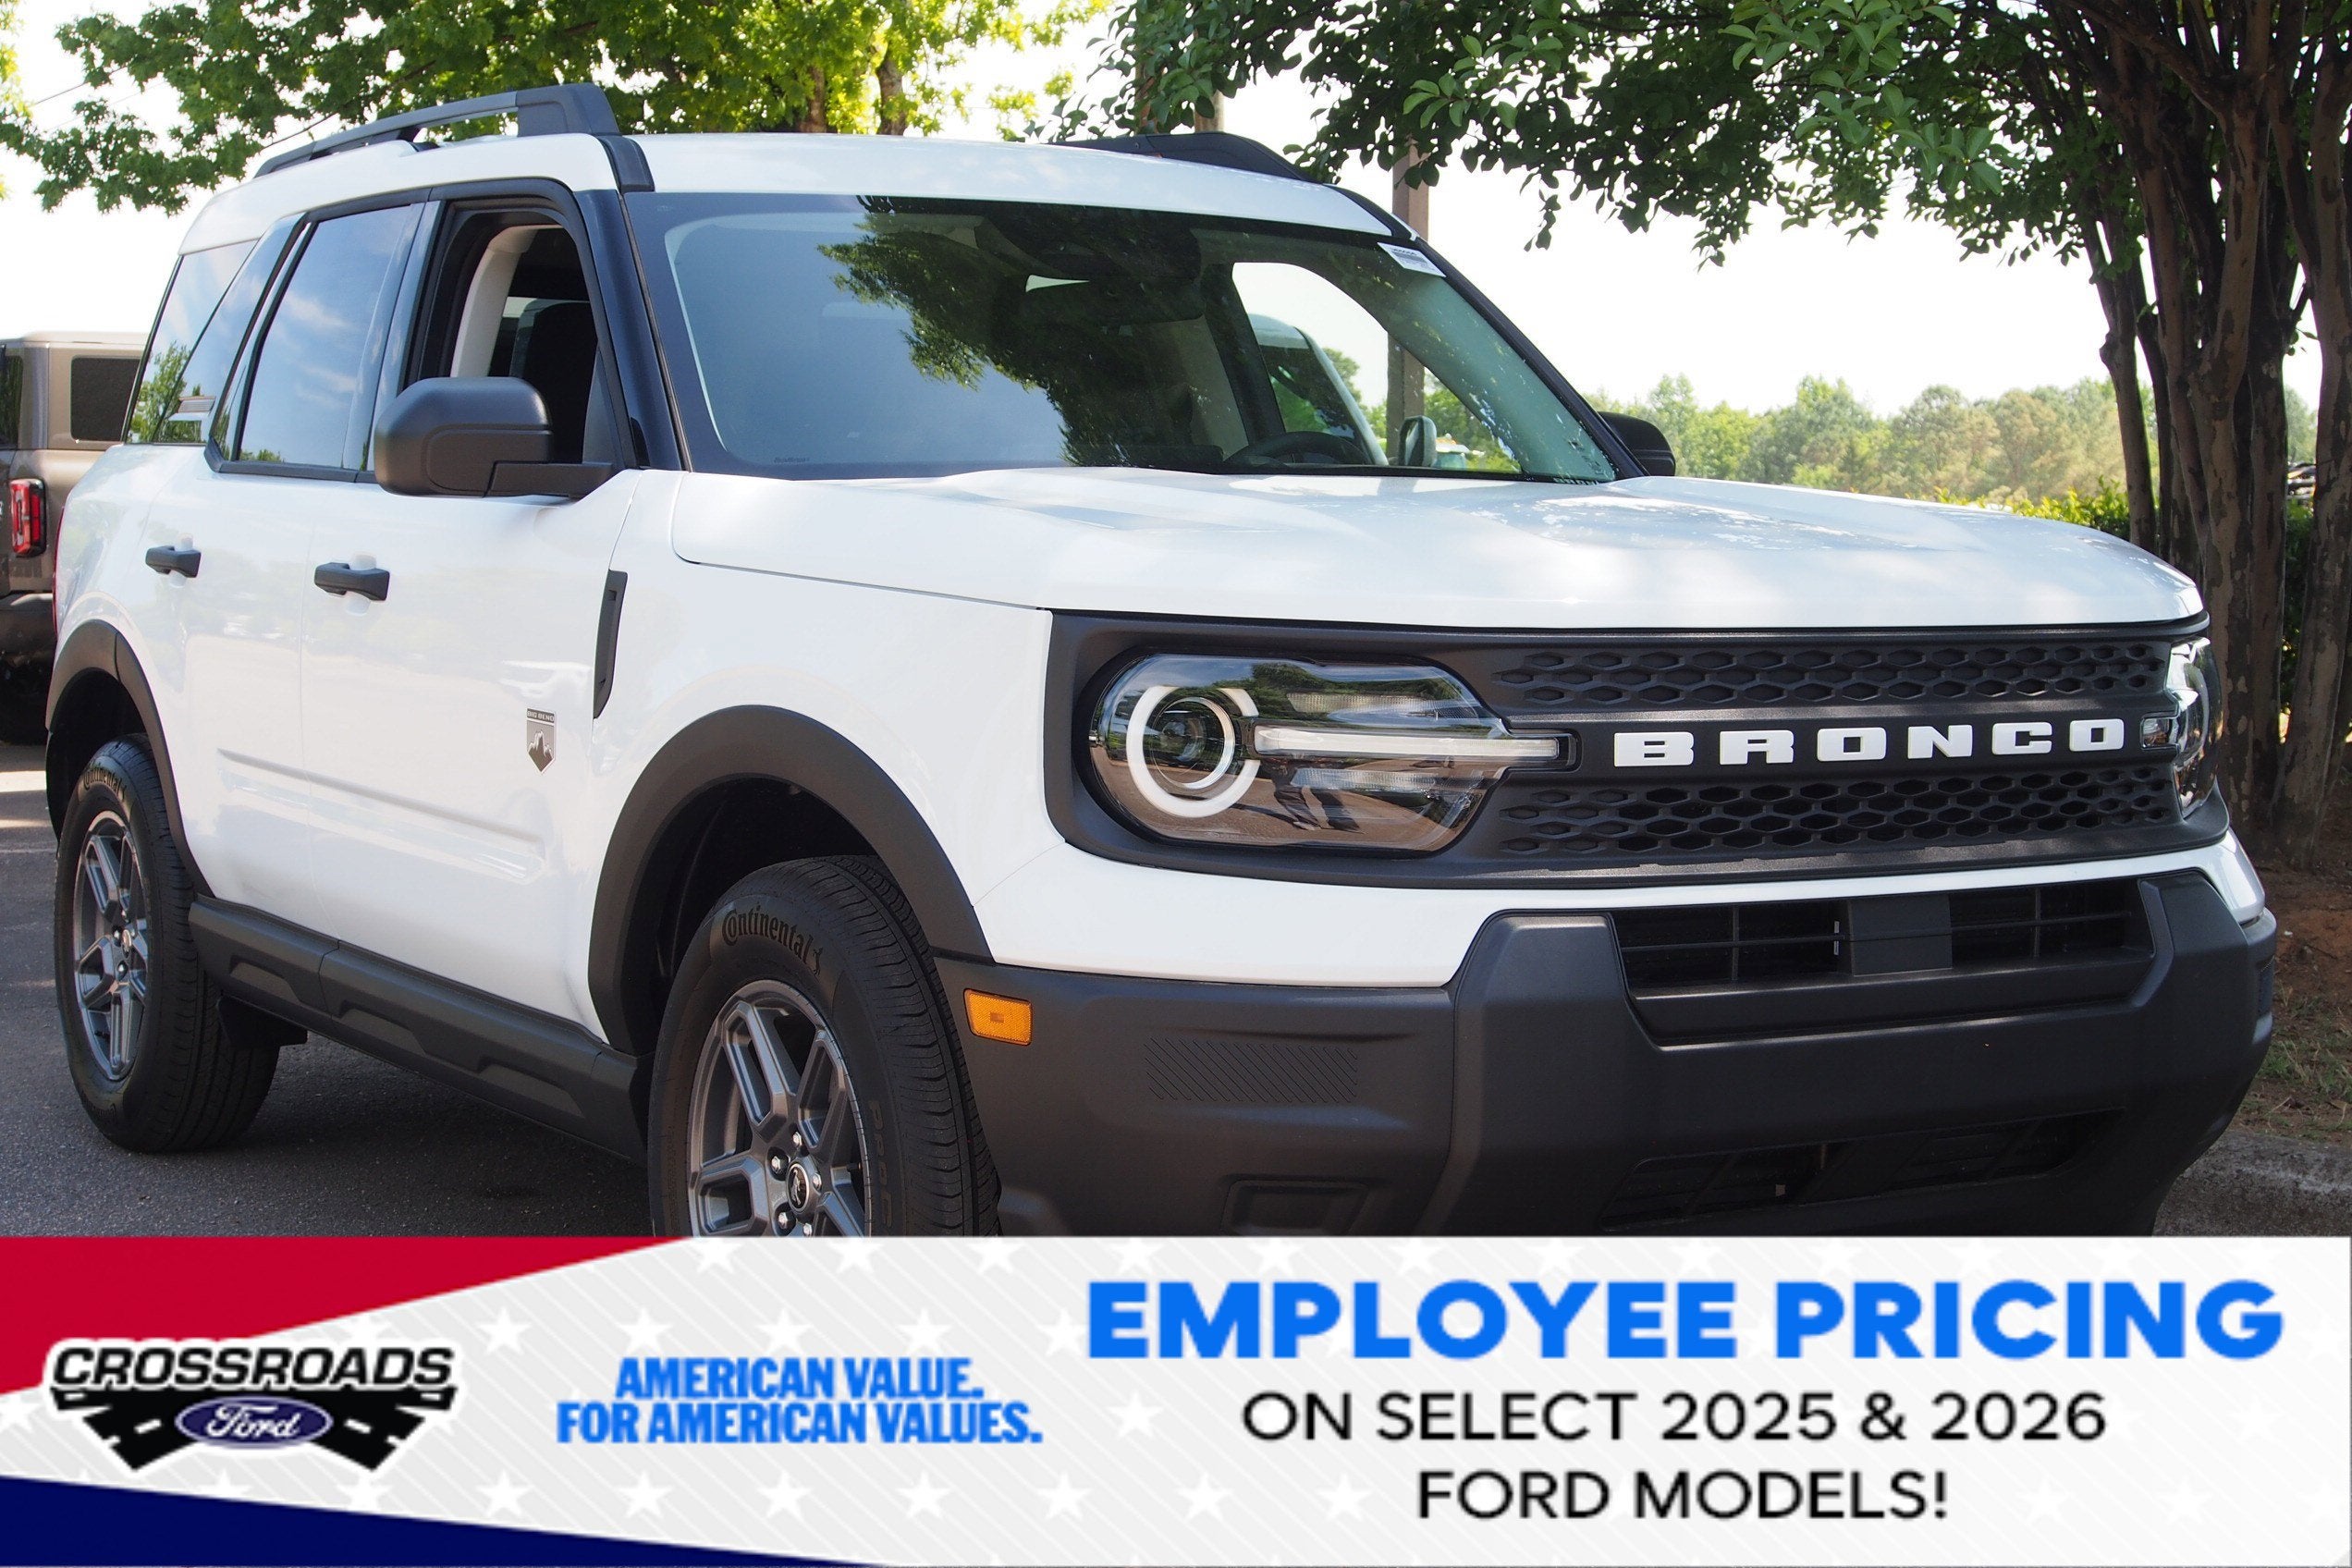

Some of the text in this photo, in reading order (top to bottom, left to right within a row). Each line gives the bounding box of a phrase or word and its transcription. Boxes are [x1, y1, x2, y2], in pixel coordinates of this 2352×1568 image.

[527, 711, 555, 721] BIG BEND
[1613, 718, 2125, 767] BRONCO
[722, 905, 814, 963] Continental
